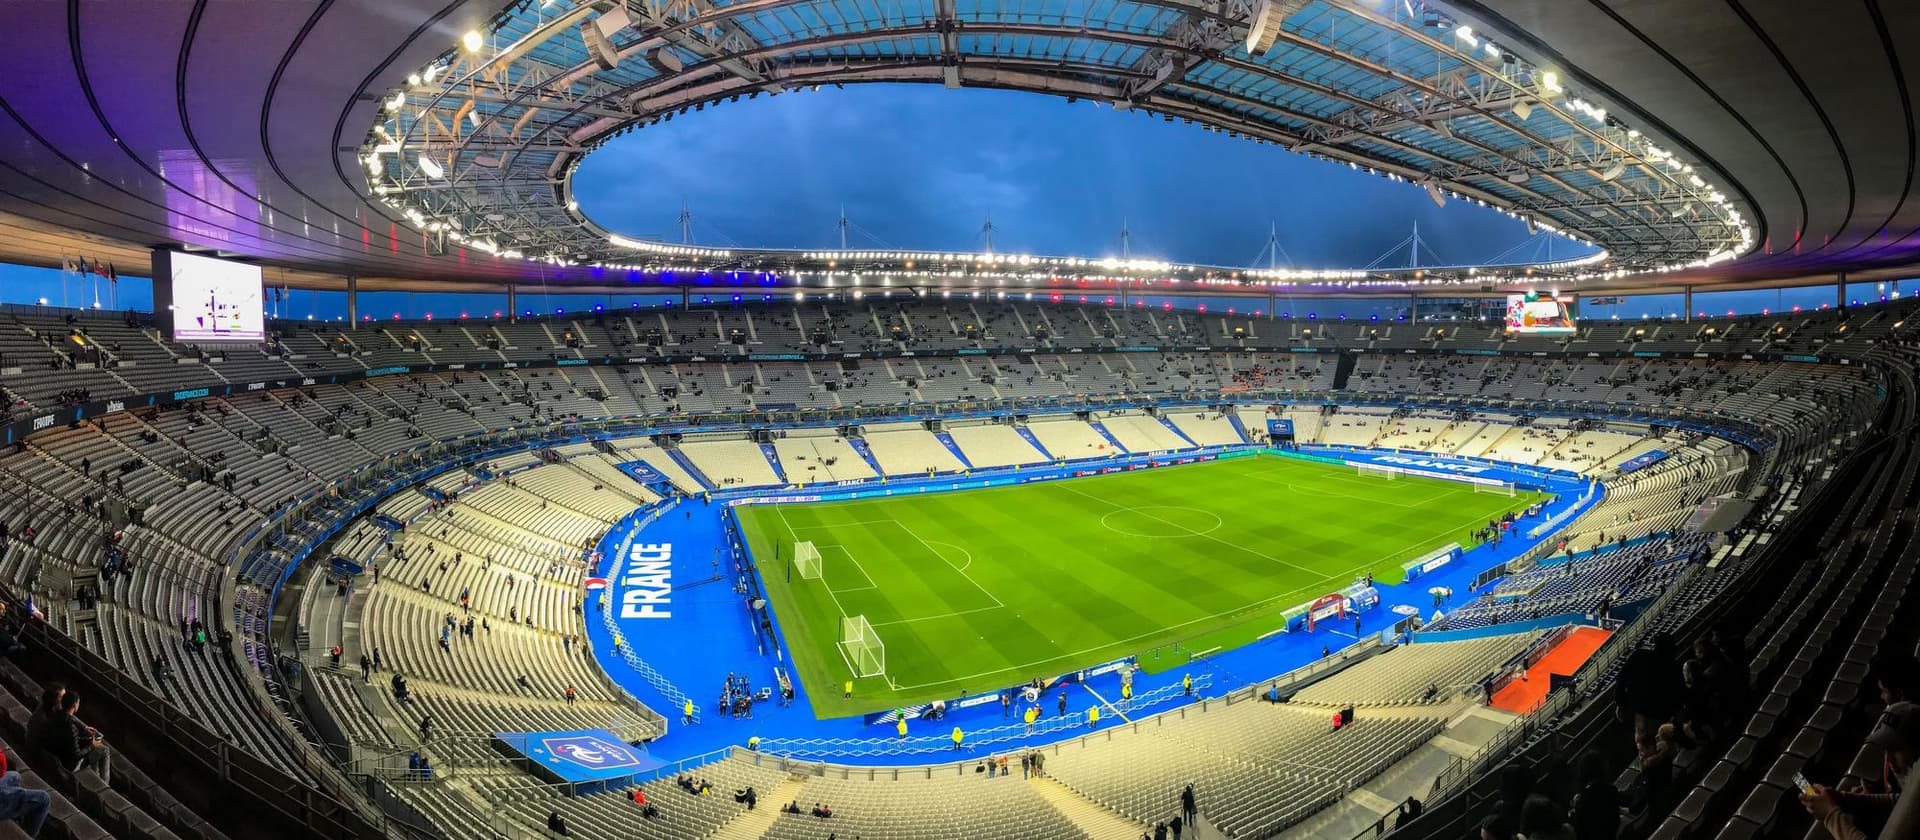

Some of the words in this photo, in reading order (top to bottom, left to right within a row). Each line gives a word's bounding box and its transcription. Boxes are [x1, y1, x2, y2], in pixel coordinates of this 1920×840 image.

[1372, 456, 1489, 473] FRANCE
[837, 478, 865, 487] FRANCE
[620, 543, 672, 618] FRANCE
